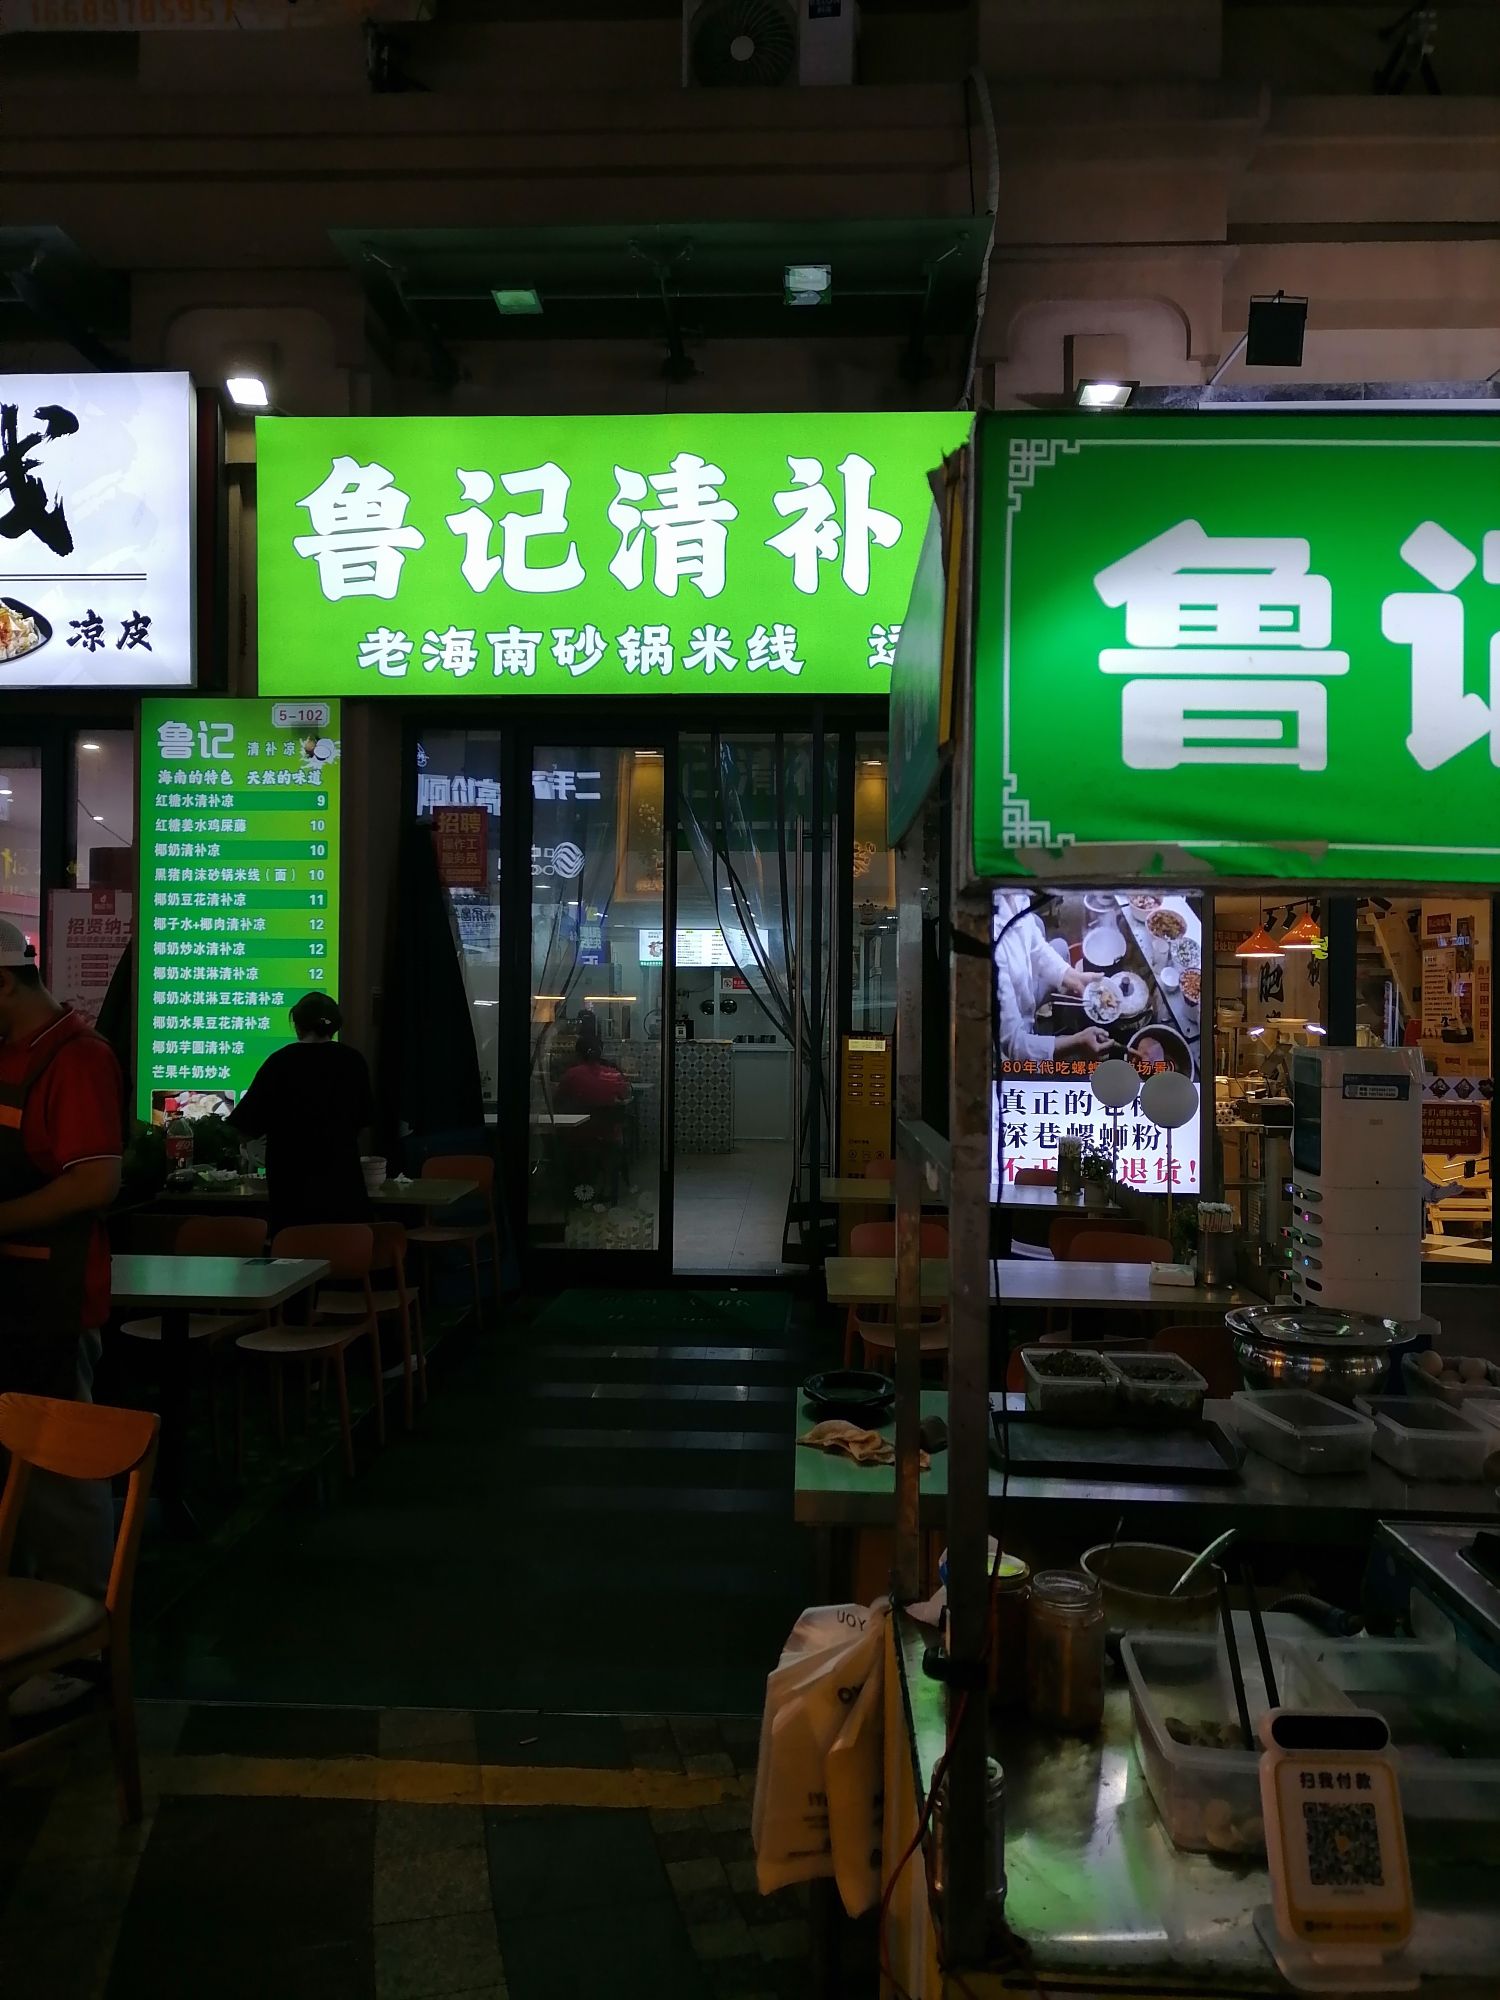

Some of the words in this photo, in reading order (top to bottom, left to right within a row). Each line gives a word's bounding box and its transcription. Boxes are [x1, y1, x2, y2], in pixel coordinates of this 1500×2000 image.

[293, 452, 903, 601] 鲁记清补
[66, 608, 153, 653] 凉皮
[357, 623, 806, 677] 老海南砂锅米线
[279, 709, 323, 721] 5-102
[157, 720, 235, 759] 鲁记
[247, 741, 296, 757] 清补凉
[158, 769, 234, 785] 海南的特色
[247, 769, 323, 786] 天然的味道
[155, 793, 234, 808] 红糖水清补凉
[317, 795, 326, 807] 9
[310, 820, 325, 832] 10
[438, 812, 481, 833] 招聘
[154, 843, 221, 857] 椰奶清补凉
[310, 844, 325, 856] 10
[309, 869, 325, 881] 10
[154, 892, 247, 907] 椰奶豆花清补凉
[309, 894, 324, 905] 11
[153, 917, 266, 931] 椰子水+椰肉清补凉
[309, 919, 324, 930] 12
[153, 942, 246, 956] 椰奶炒冰清补凉
[309, 943, 324, 955] 12
[153, 966, 259, 980] 椰奶冰淇淋清补凉
[309, 968, 324, 980] 12
[152, 991, 285, 1005] 椰奶冰淇淋豆花清补凉
[152, 1016, 271, 1030] 椰奶水果豆花清补凉
[152, 1065, 231, 1079] 芒果牛奶炒冰
[1001, 1089, 1147, 1117] 真正的
[1001, 1122, 1162, 1151] 深巷螺蛳粉
